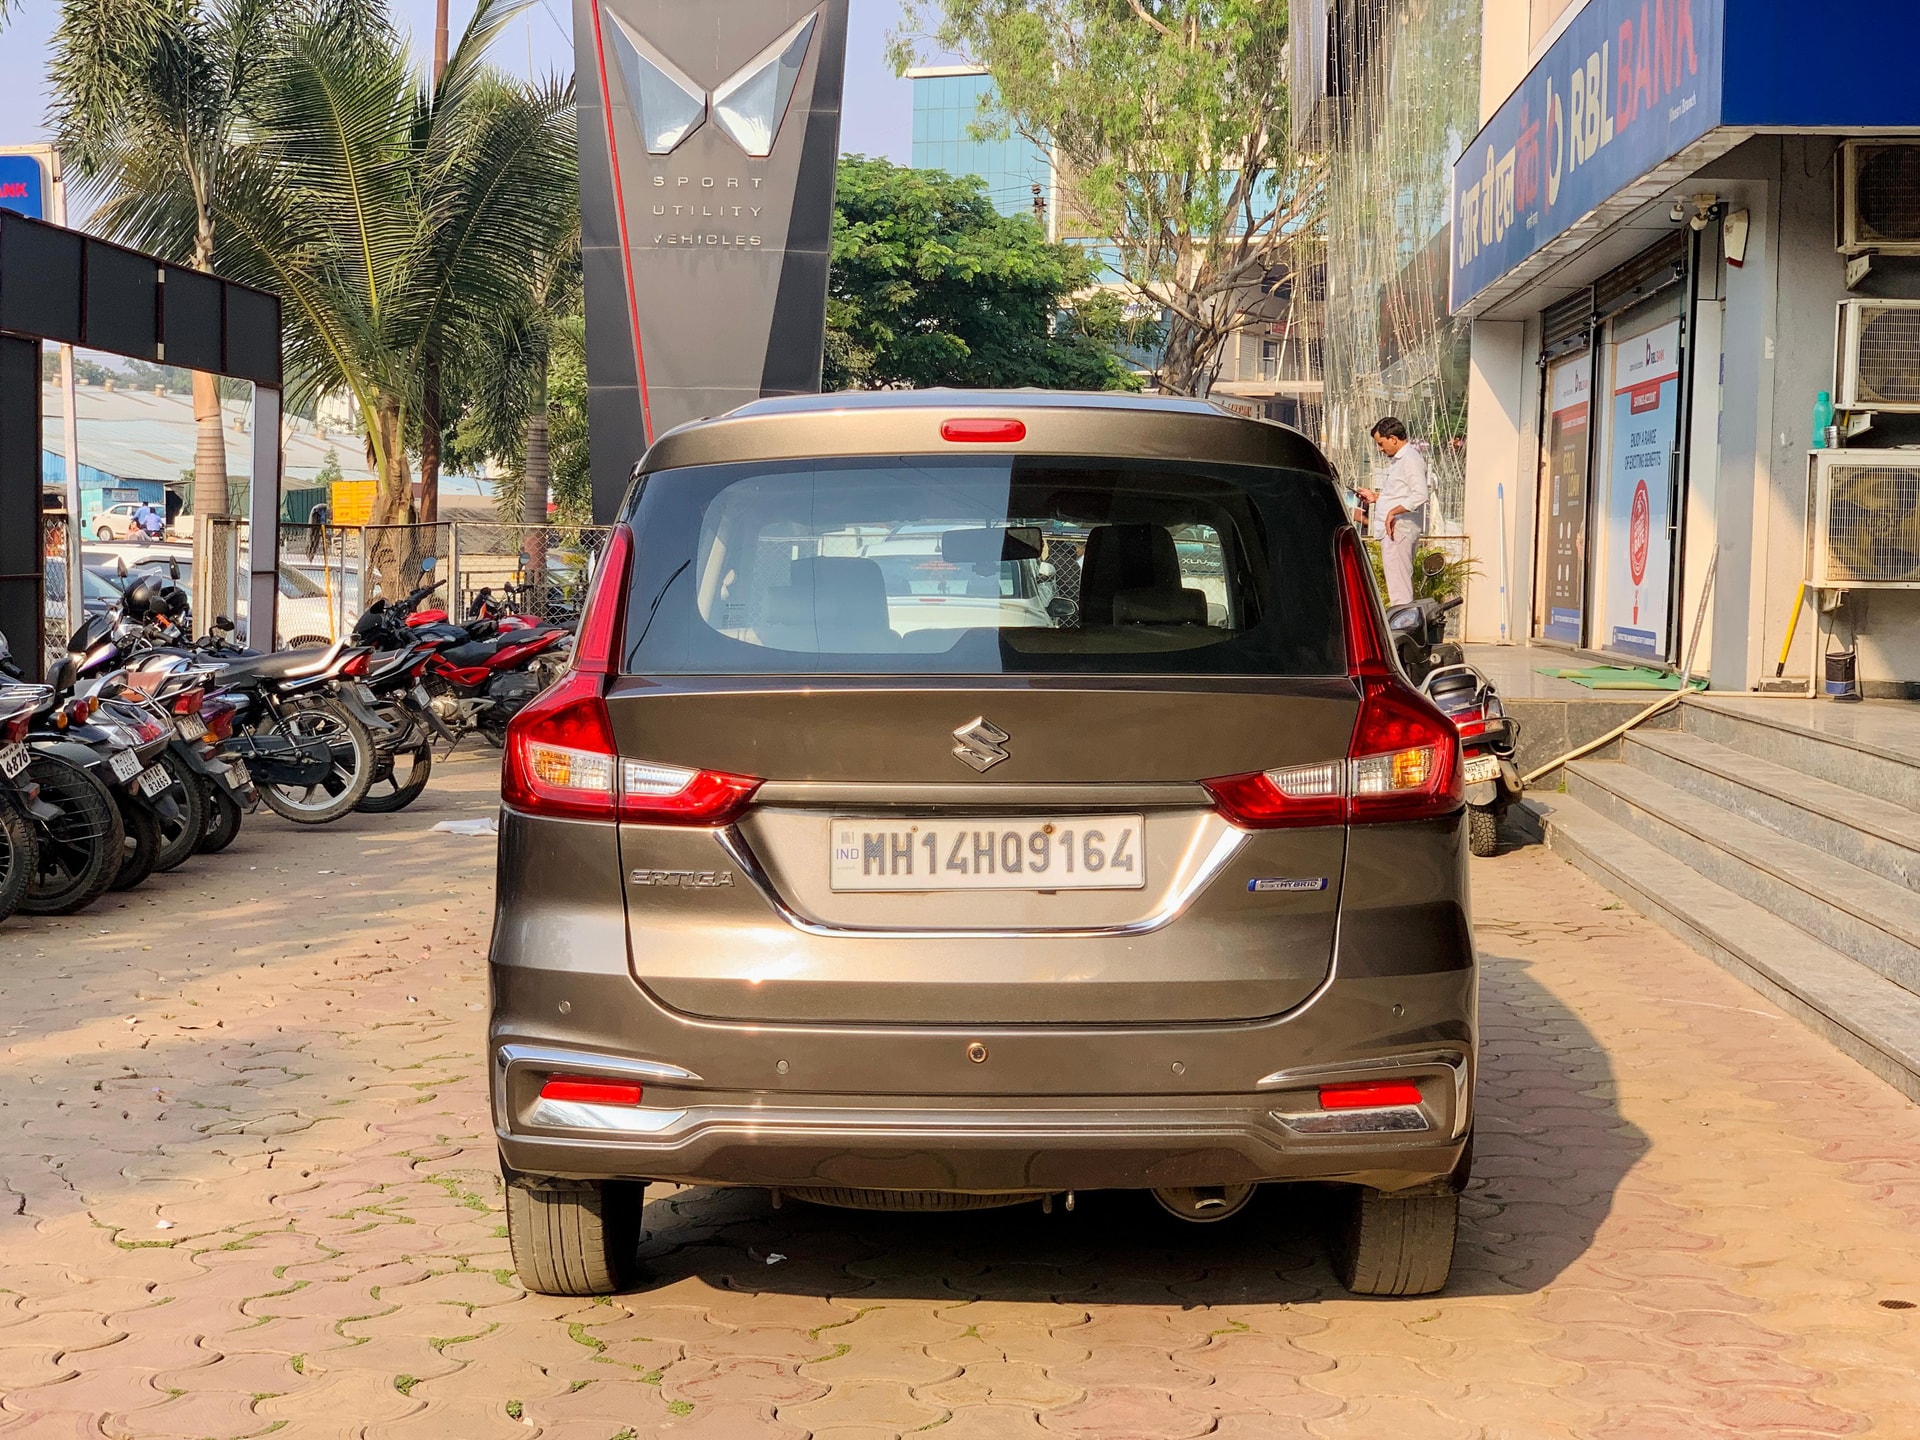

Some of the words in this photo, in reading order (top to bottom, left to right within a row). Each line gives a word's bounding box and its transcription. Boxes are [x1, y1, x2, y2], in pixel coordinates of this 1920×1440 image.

[1569, 40, 1614, 174] RBL
[1615, 0, 1698, 136] BANK
[653, 176, 762, 188] SPORT
[653, 205, 762, 217] UTILITY
[654, 234, 761, 246] VEHICLES
[6, 748, 28, 775] 4876
[836, 848, 859, 860] IND
[863, 829, 1133, 875] MH14HQ9164
[630, 869, 735, 887] ERTIGA
